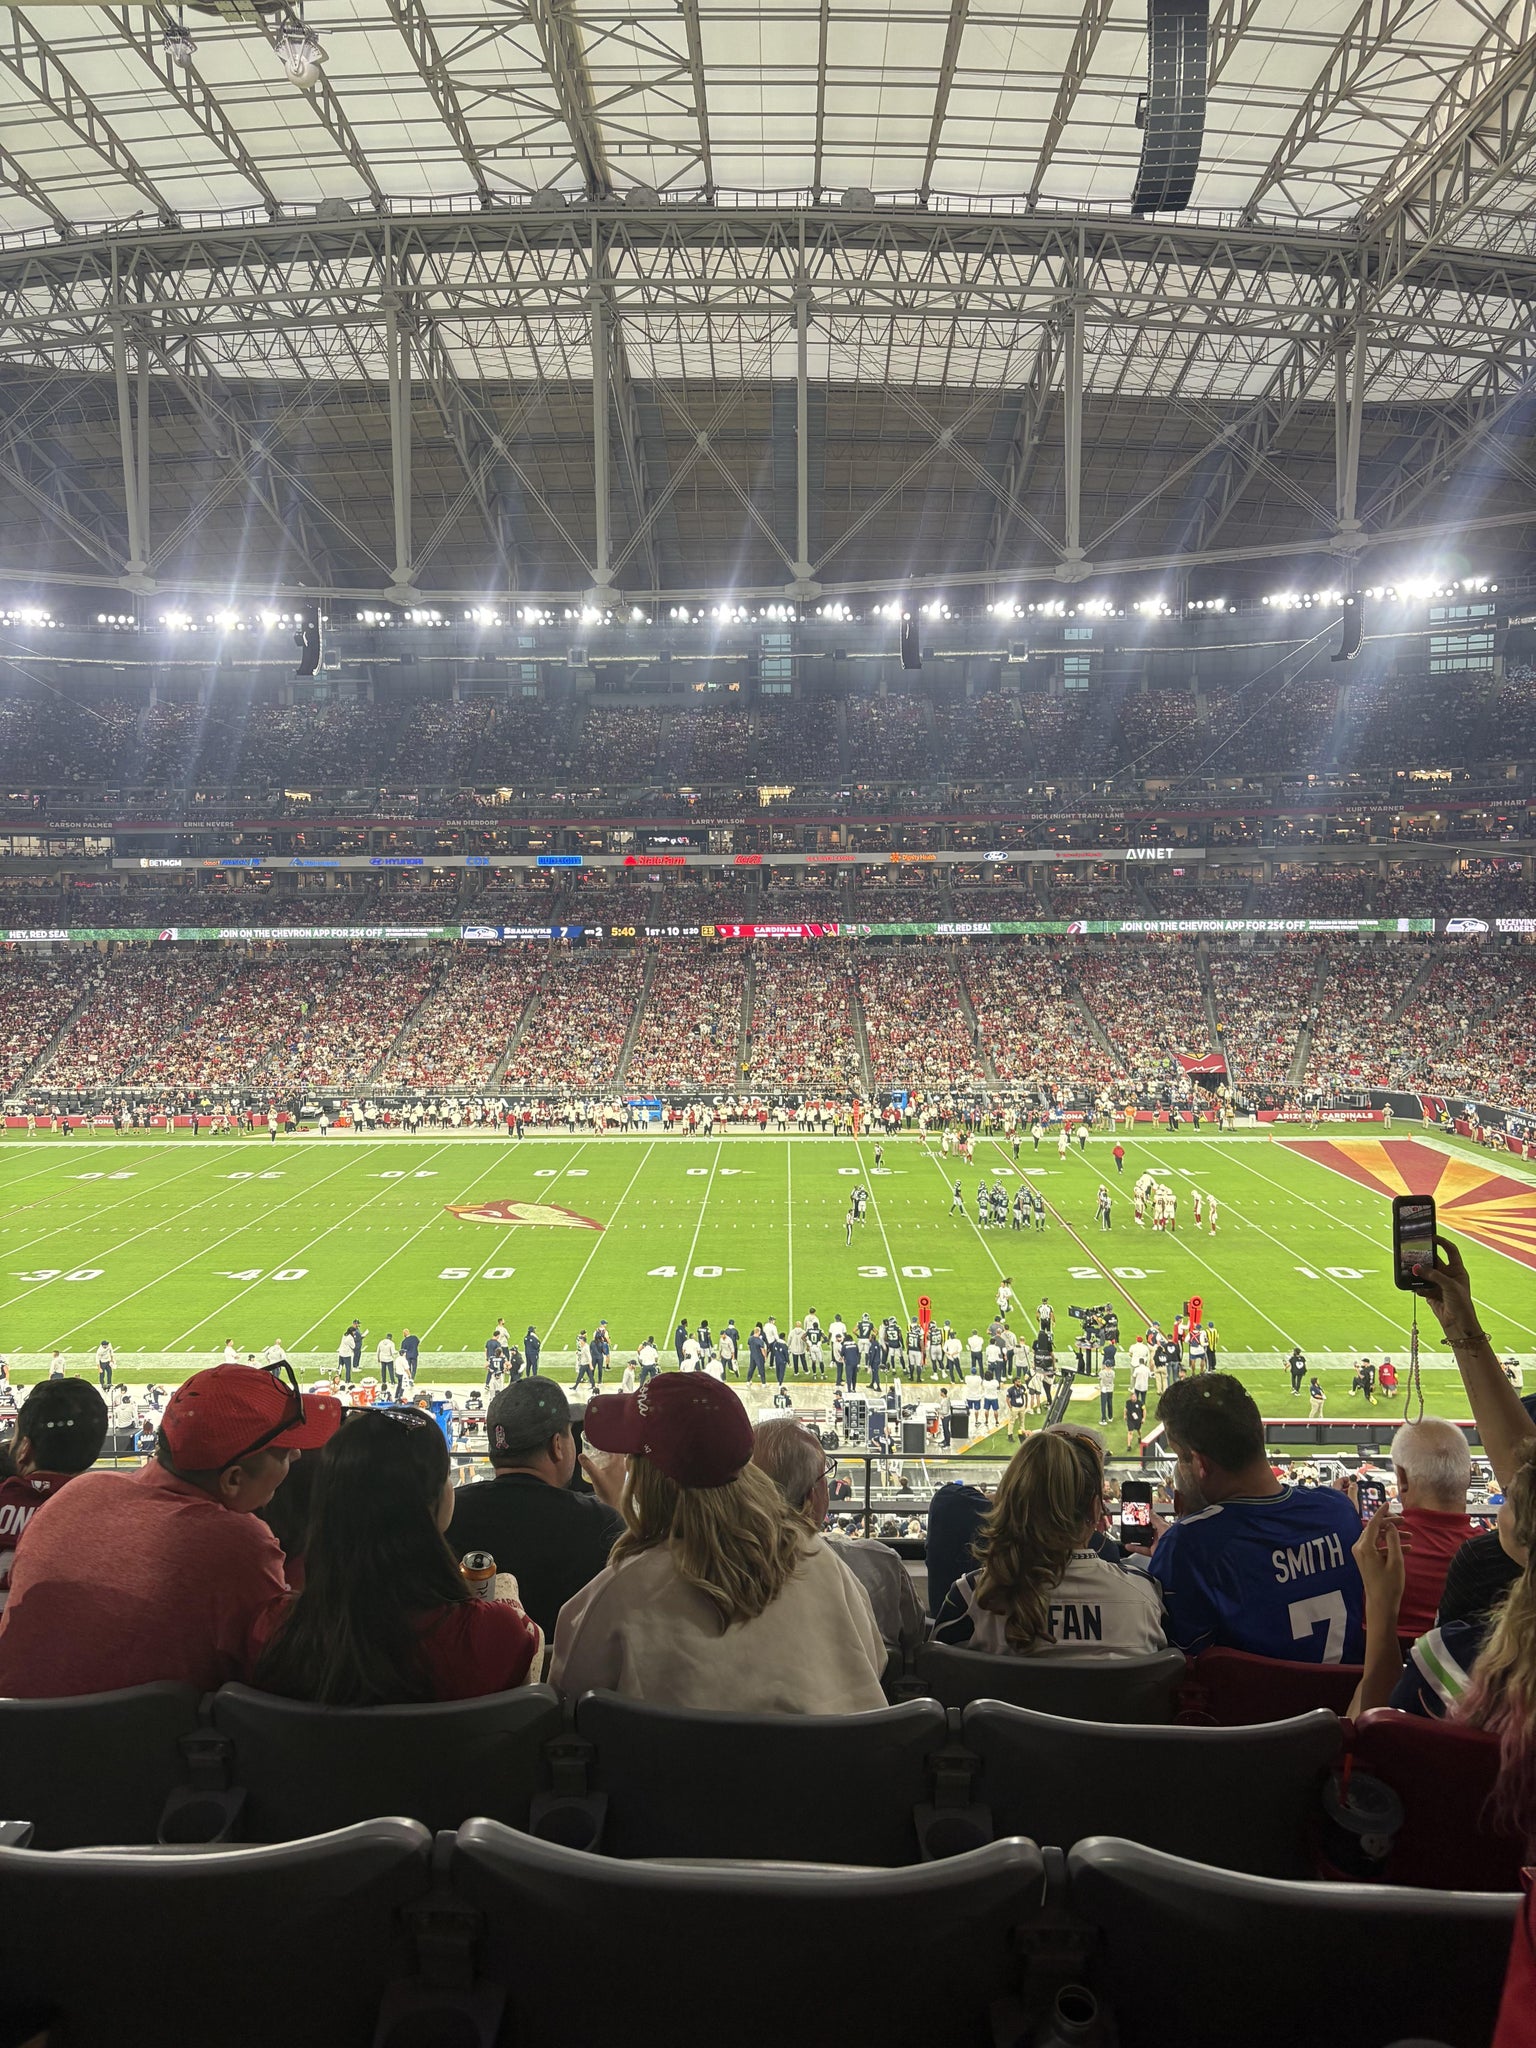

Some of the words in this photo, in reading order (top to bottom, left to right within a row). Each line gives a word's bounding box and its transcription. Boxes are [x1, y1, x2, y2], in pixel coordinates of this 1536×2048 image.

[1049, 812, 1077, 820] (NIGHT
[1077, 812, 1104, 820] TRAIN)
[1126, 848, 1174, 860] AVNET
[149, 859, 182, 867] BETMGM
[503, 927, 552, 935] SEAHAWKS
[733, 926, 741, 936] 3
[937, 923, 954, 932] HEY,
[955, 923, 972, 931] RED
[972, 922, 991, 931] SEA!
[1120, 921, 1142, 931] JOIN
[1144, 921, 1158, 931] ON
[1159, 921, 1178, 930] THE
[1179, 921, 1224, 930] CHEVRON
[1225, 921, 1245, 930] APP
[1246, 921, 1266, 930] FOR
[1286, 921, 1306, 930] OFF
[9, 930, 28, 939] HEY,
[30, 930, 47, 938] RED
[48, 930, 69, 938] SEA!
[219, 929, 238, 938] JOIN
[240, 929, 253, 938] ON
[254, 929, 270, 938] THE
[271, 929, 312, 938] CHEVRON
[313, 928, 330, 937] APP
[331, 928, 348, 937] FOR
[365, 928, 383, 937] OFF
[560, 927, 568, 937] 7
[595, 927, 603, 936] 2
[611, 926, 636, 937] 5:40
[645, 927, 660, 936] 1ST
[667, 927, 680, 936] 10
[1322, 1112, 1374, 1120] CARDINALS
[19, 1268, 105, 1281] 30
[226, 1268, 310, 1281] 40
[437, 1267, 517, 1280] 50
[647, 1265, 724, 1278] 40
[857, 1265, 933, 1278] 30
[1066, 1266, 1148, 1279] 20
[1294, 1266, 1366, 1279] 10
[862, 1326, 870, 1336] 7
[886, 1330, 899, 1340] 53
[811, 1332, 818, 1343] 0
[908, 1337, 918, 1347] 91
[493, 1360, 501, 1371] 4
[1271, 1532, 1345, 1583] SMITH
[1048, 1604, 1102, 1641] FAN
[1287, 1589, 1348, 1665] 7
